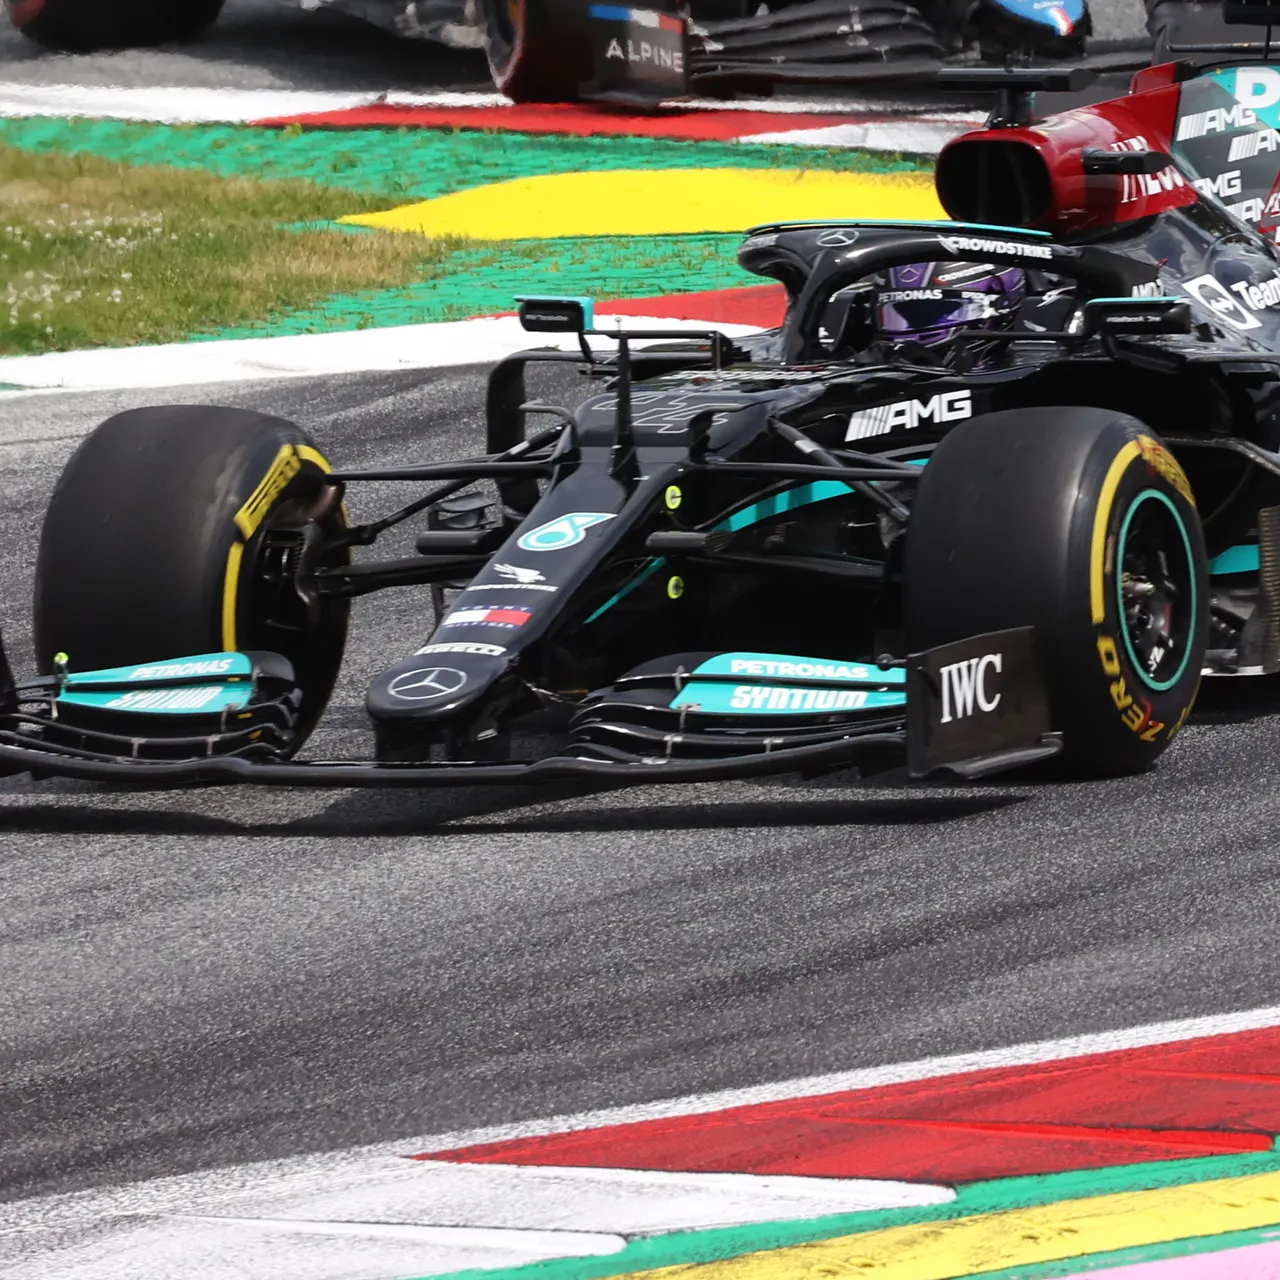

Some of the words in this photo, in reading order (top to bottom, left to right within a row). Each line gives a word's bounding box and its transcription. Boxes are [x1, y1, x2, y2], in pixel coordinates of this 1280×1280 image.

[605, 37, 685, 74] ALPINE
[1203, 103, 1257, 134] AMG
[951, 235, 1053, 260] CROWDSTRIKE
[878, 288, 944, 304] PETRONAS
[885, 389, 972, 432] AMG
[128, 658, 235, 679] PETRONAS
[730, 659, 869, 679] PETRONAS
[730, 685, 869, 710] SYNTIUM
[940, 653, 1002, 724] IWC
